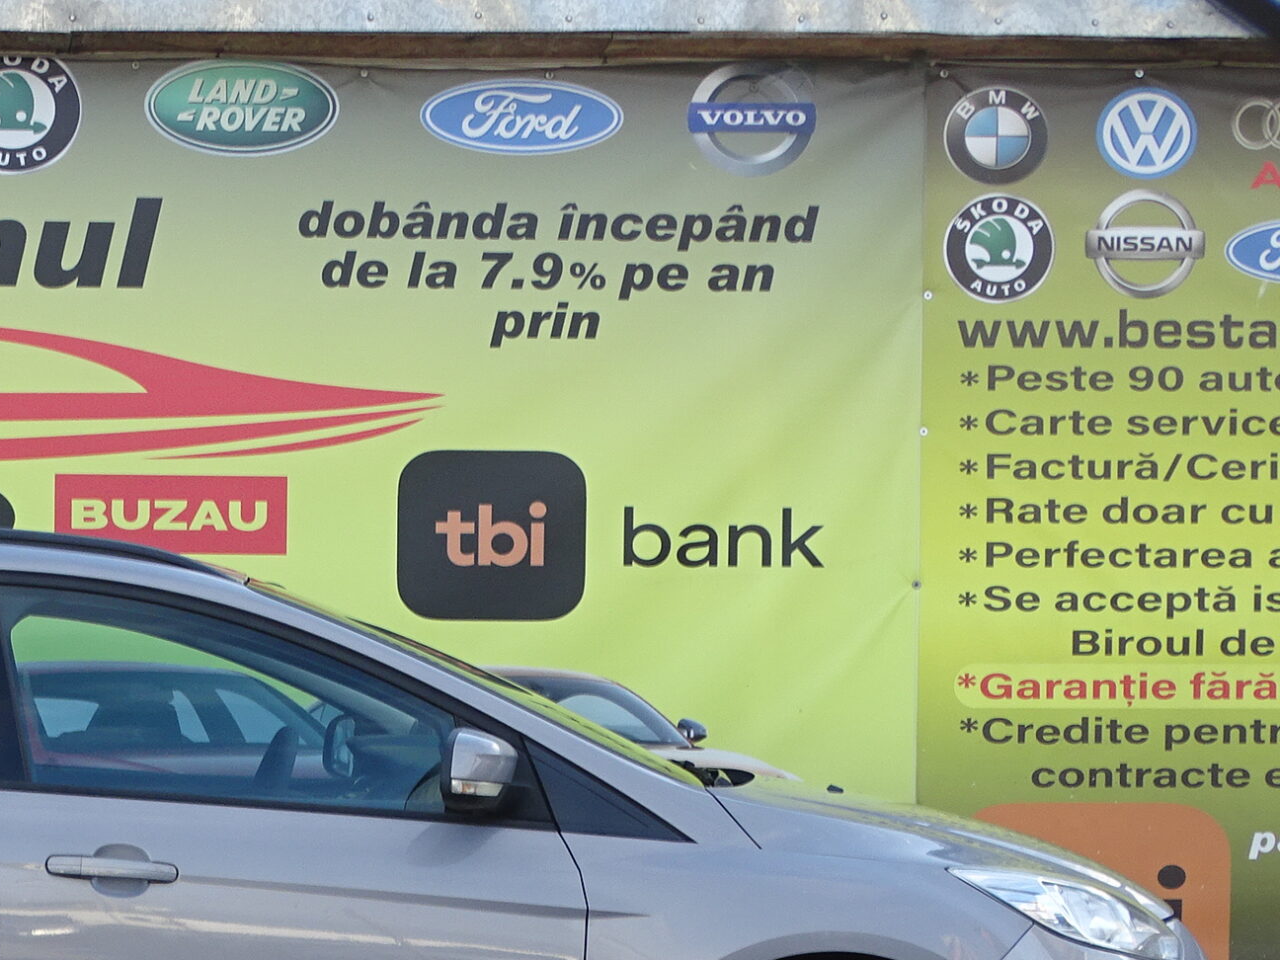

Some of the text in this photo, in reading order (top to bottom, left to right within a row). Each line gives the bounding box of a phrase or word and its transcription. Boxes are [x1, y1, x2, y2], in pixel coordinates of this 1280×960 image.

[462, 89, 586, 140] Ford
[697, 109, 807, 128] VOLVO
[956, 90, 1040, 120] BMW
[298, 201, 820, 251] dobânda începând
[1096, 235, 1193, 253] NISSAN
[321, 250, 389, 289] de
[407, 253, 457, 289] la
[619, 258, 689, 300] pe
[707, 262, 775, 291] an
[970, 278, 1027, 297] AUTO
[490, 303, 600, 348] prin
[957, 308, 1277, 350] www.besta
[1128, 366, 1184, 392] 90
[1199, 366, 1280, 392] aut
[71, 498, 268, 532] BUZAU
[1102, 496, 1207, 525] doar
[1221, 504, 1273, 525] cu
[435, 501, 825, 568] tbi bank
[1054, 585, 1237, 620] acceptă
[1071, 628, 1275, 657] Biroul de
[1189, 671, 1277, 701] fără
[1031, 762, 1251, 789] contracte
